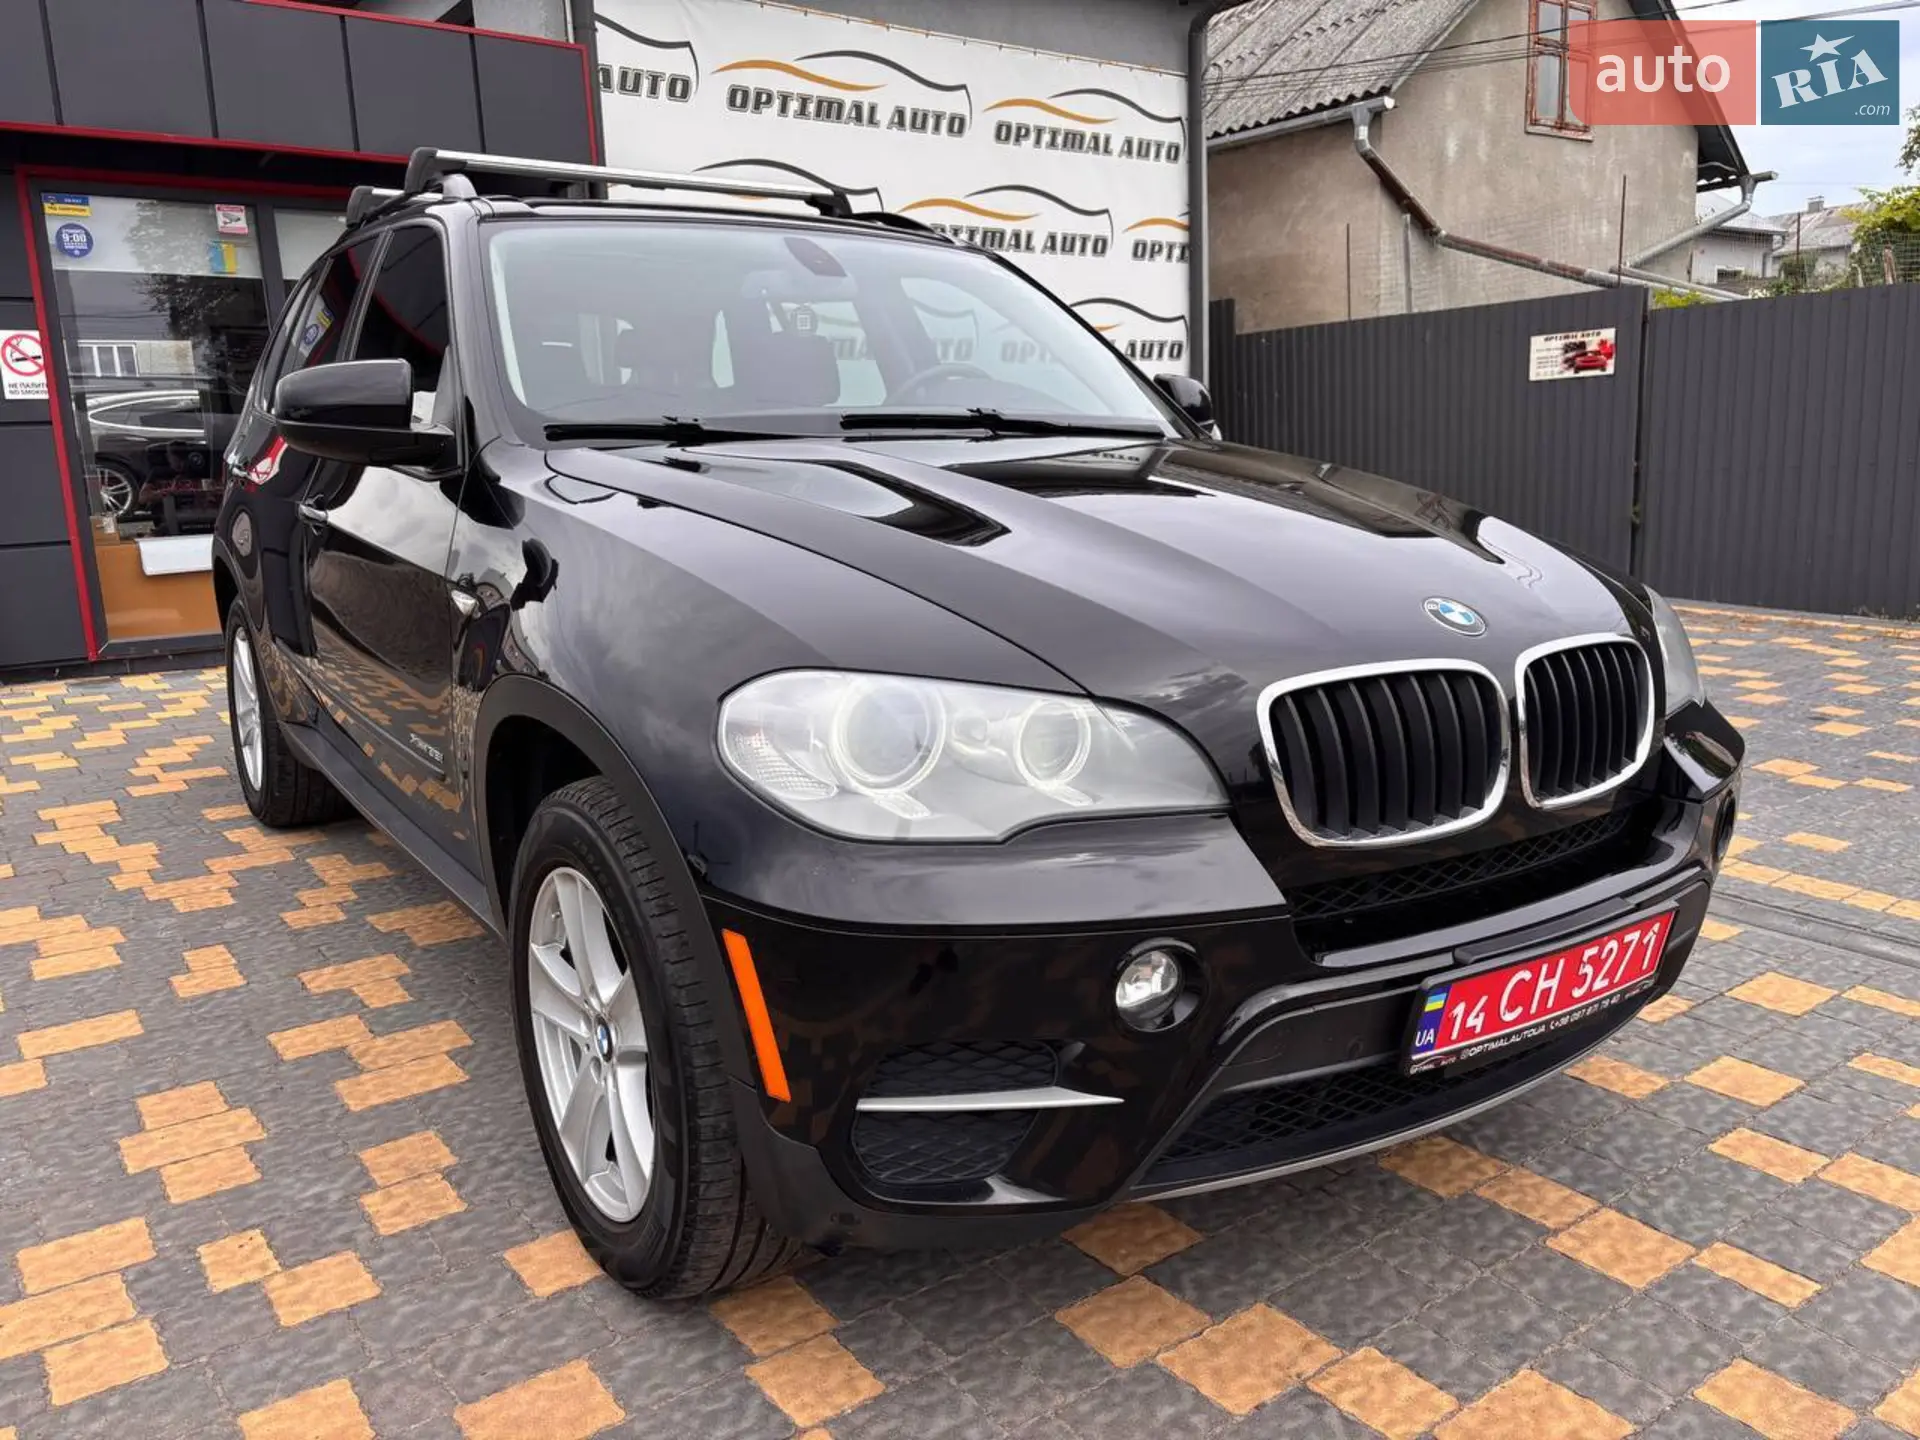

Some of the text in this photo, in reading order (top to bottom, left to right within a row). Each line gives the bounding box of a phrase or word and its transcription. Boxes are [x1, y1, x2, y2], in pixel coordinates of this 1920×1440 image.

[598, 64, 692, 103] AUTO
[726, 83, 967, 137] OPTIMAL AUTO
[994, 120, 1181, 164] OPTIMAL AUTO
[1041, 231, 1110, 257] AUTO
[1131, 239, 1189, 264] OPTI
[1124, 339, 1184, 361] AUTO
[1450, 921, 1661, 1041] 14 CH 5271
[1415, 1027, 1436, 1047] UA
